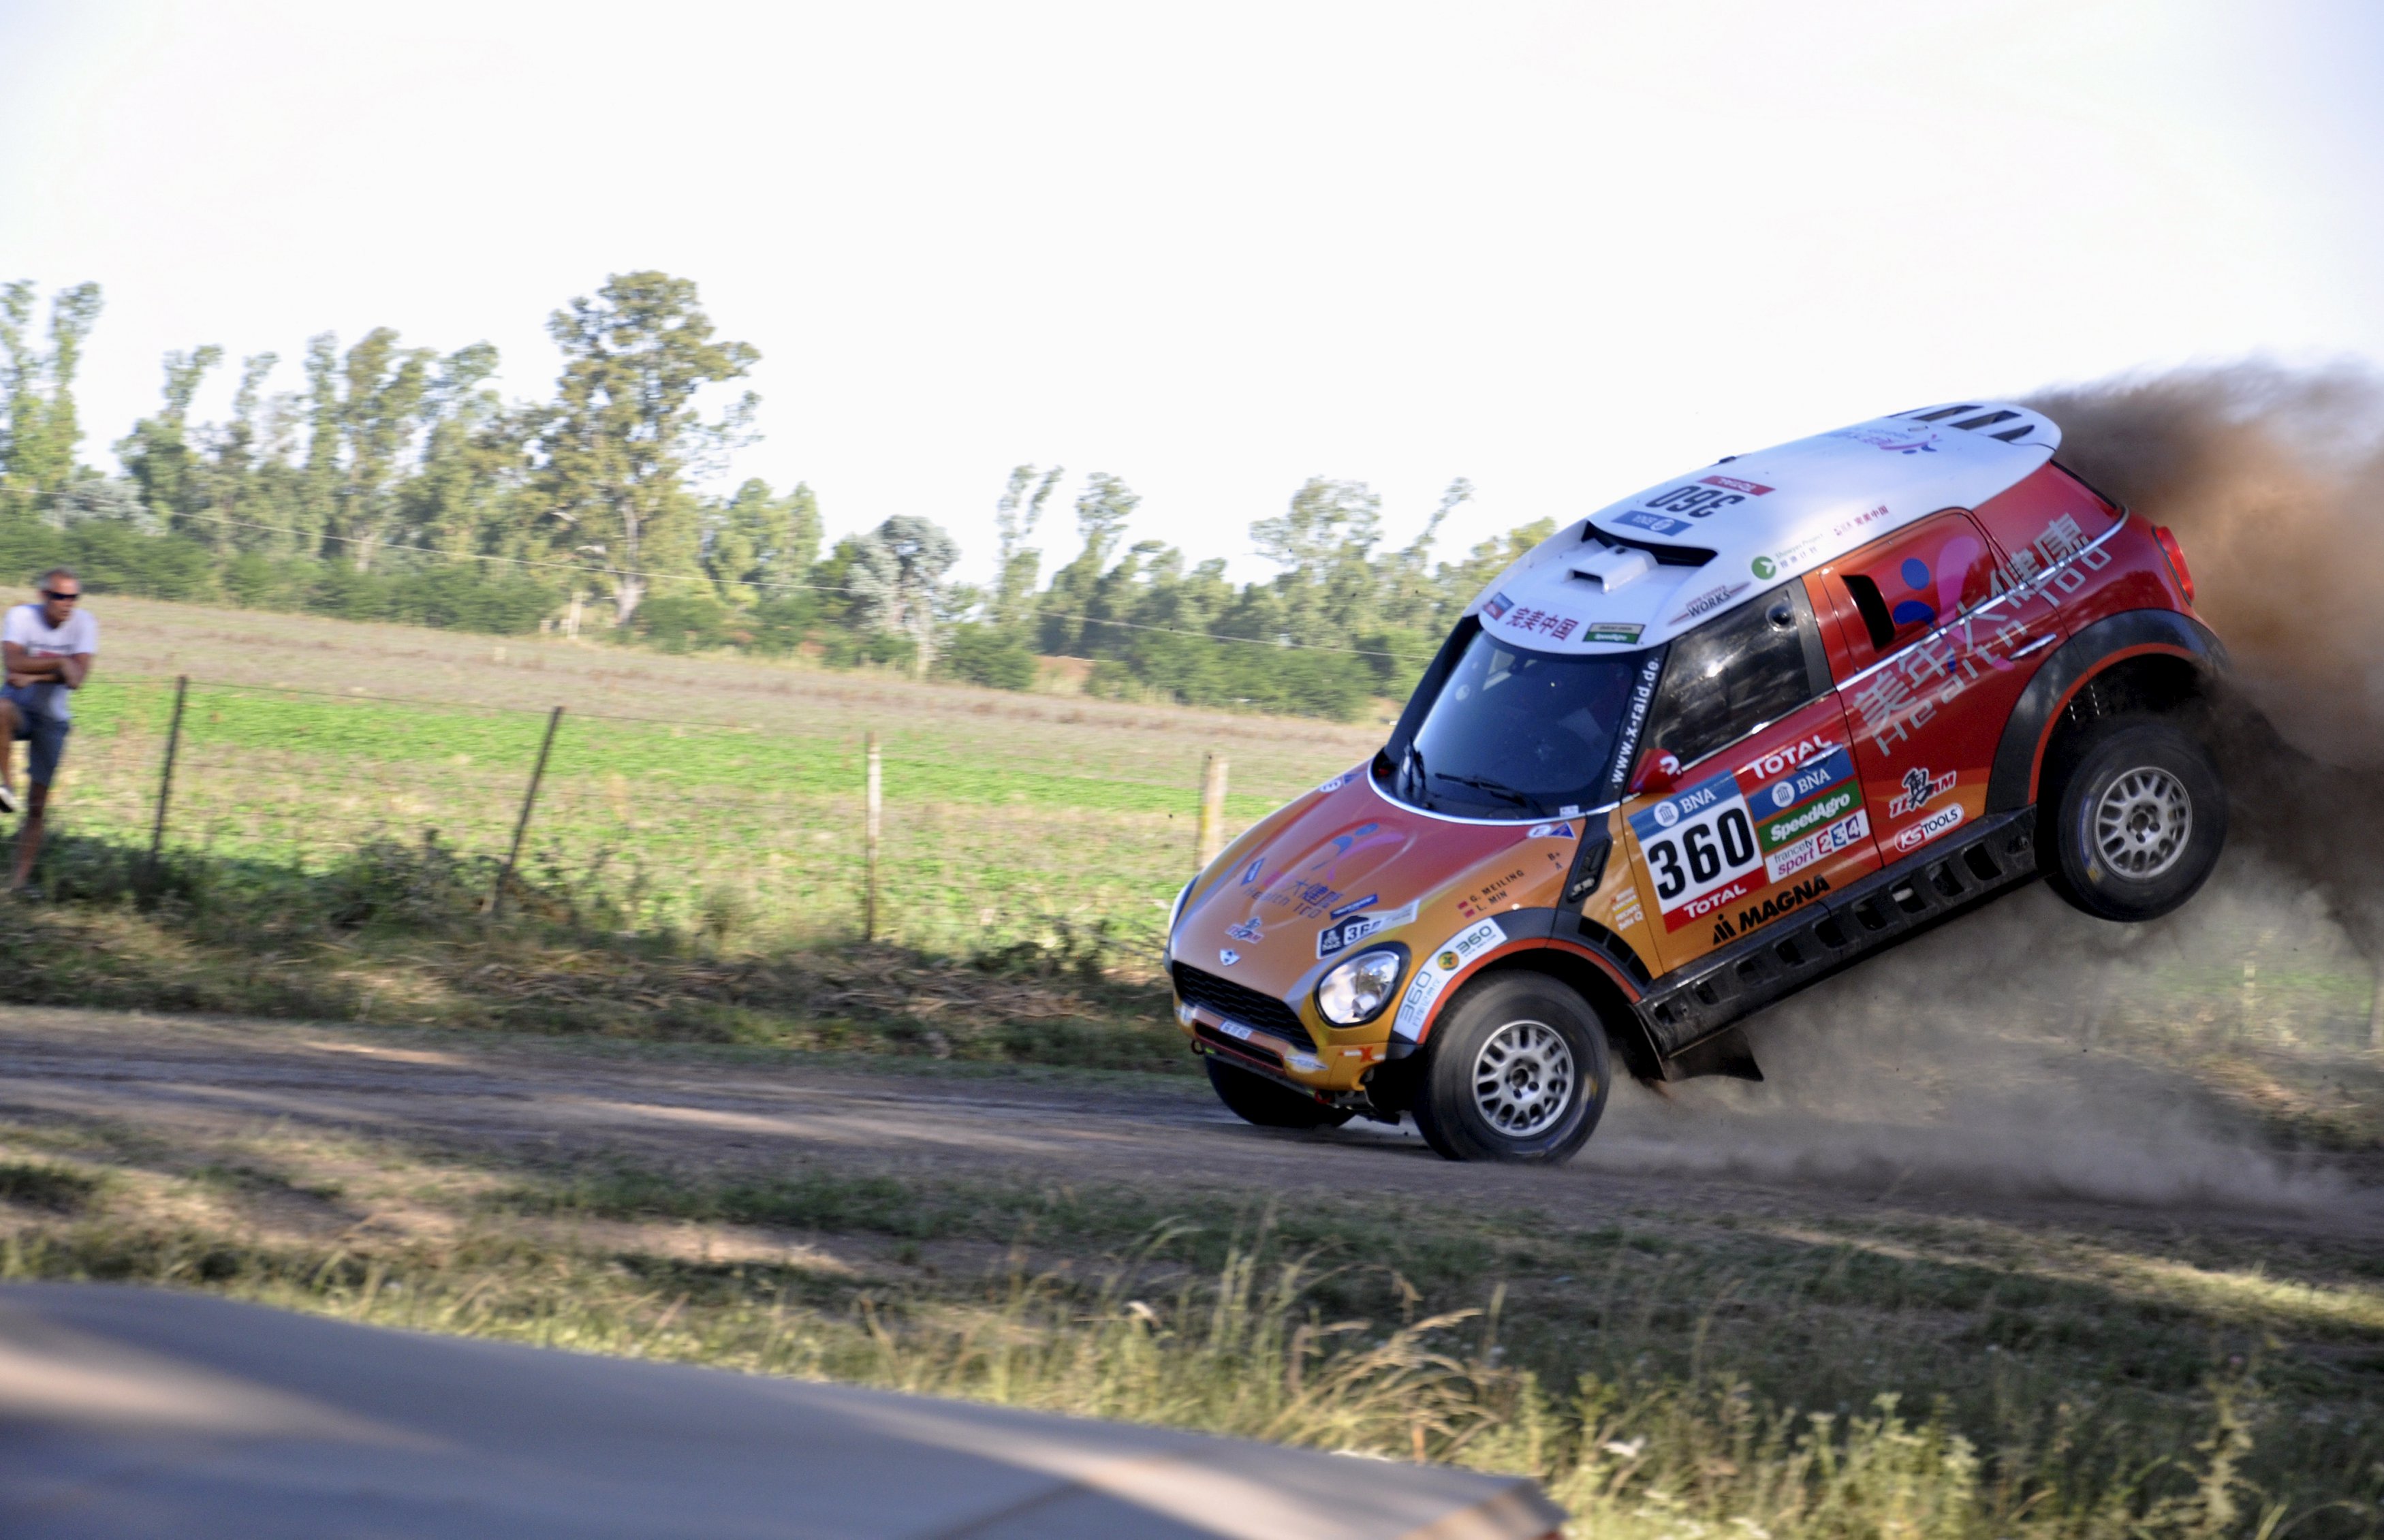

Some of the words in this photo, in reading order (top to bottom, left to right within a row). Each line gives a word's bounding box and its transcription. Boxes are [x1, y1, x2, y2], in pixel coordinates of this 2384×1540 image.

[1645, 485, 1746, 518] 360
[1689, 591, 1731, 617] WORKS
[1870, 618, 2028, 757] Health
[1746, 734, 1833, 780] TOTAL
[1796, 768, 1832, 794] BNA
[1678, 787, 1718, 815] BNA
[1770, 793, 1851, 843] SpeedAgro
[1900, 826, 1923, 849] KS
[1922, 809, 1958, 834] TOOLS
[1647, 807, 1756, 901] 360
[1777, 849, 1816, 877] sport
[1481, 868, 1525, 897] MEILING
[1488, 890, 1508, 905] MIN
[1682, 884, 1748, 919] TOTAL
[1739, 874, 1832, 934] MAGNA
[1456, 925, 1492, 955] 360
[1399, 970, 1432, 1023] 360
